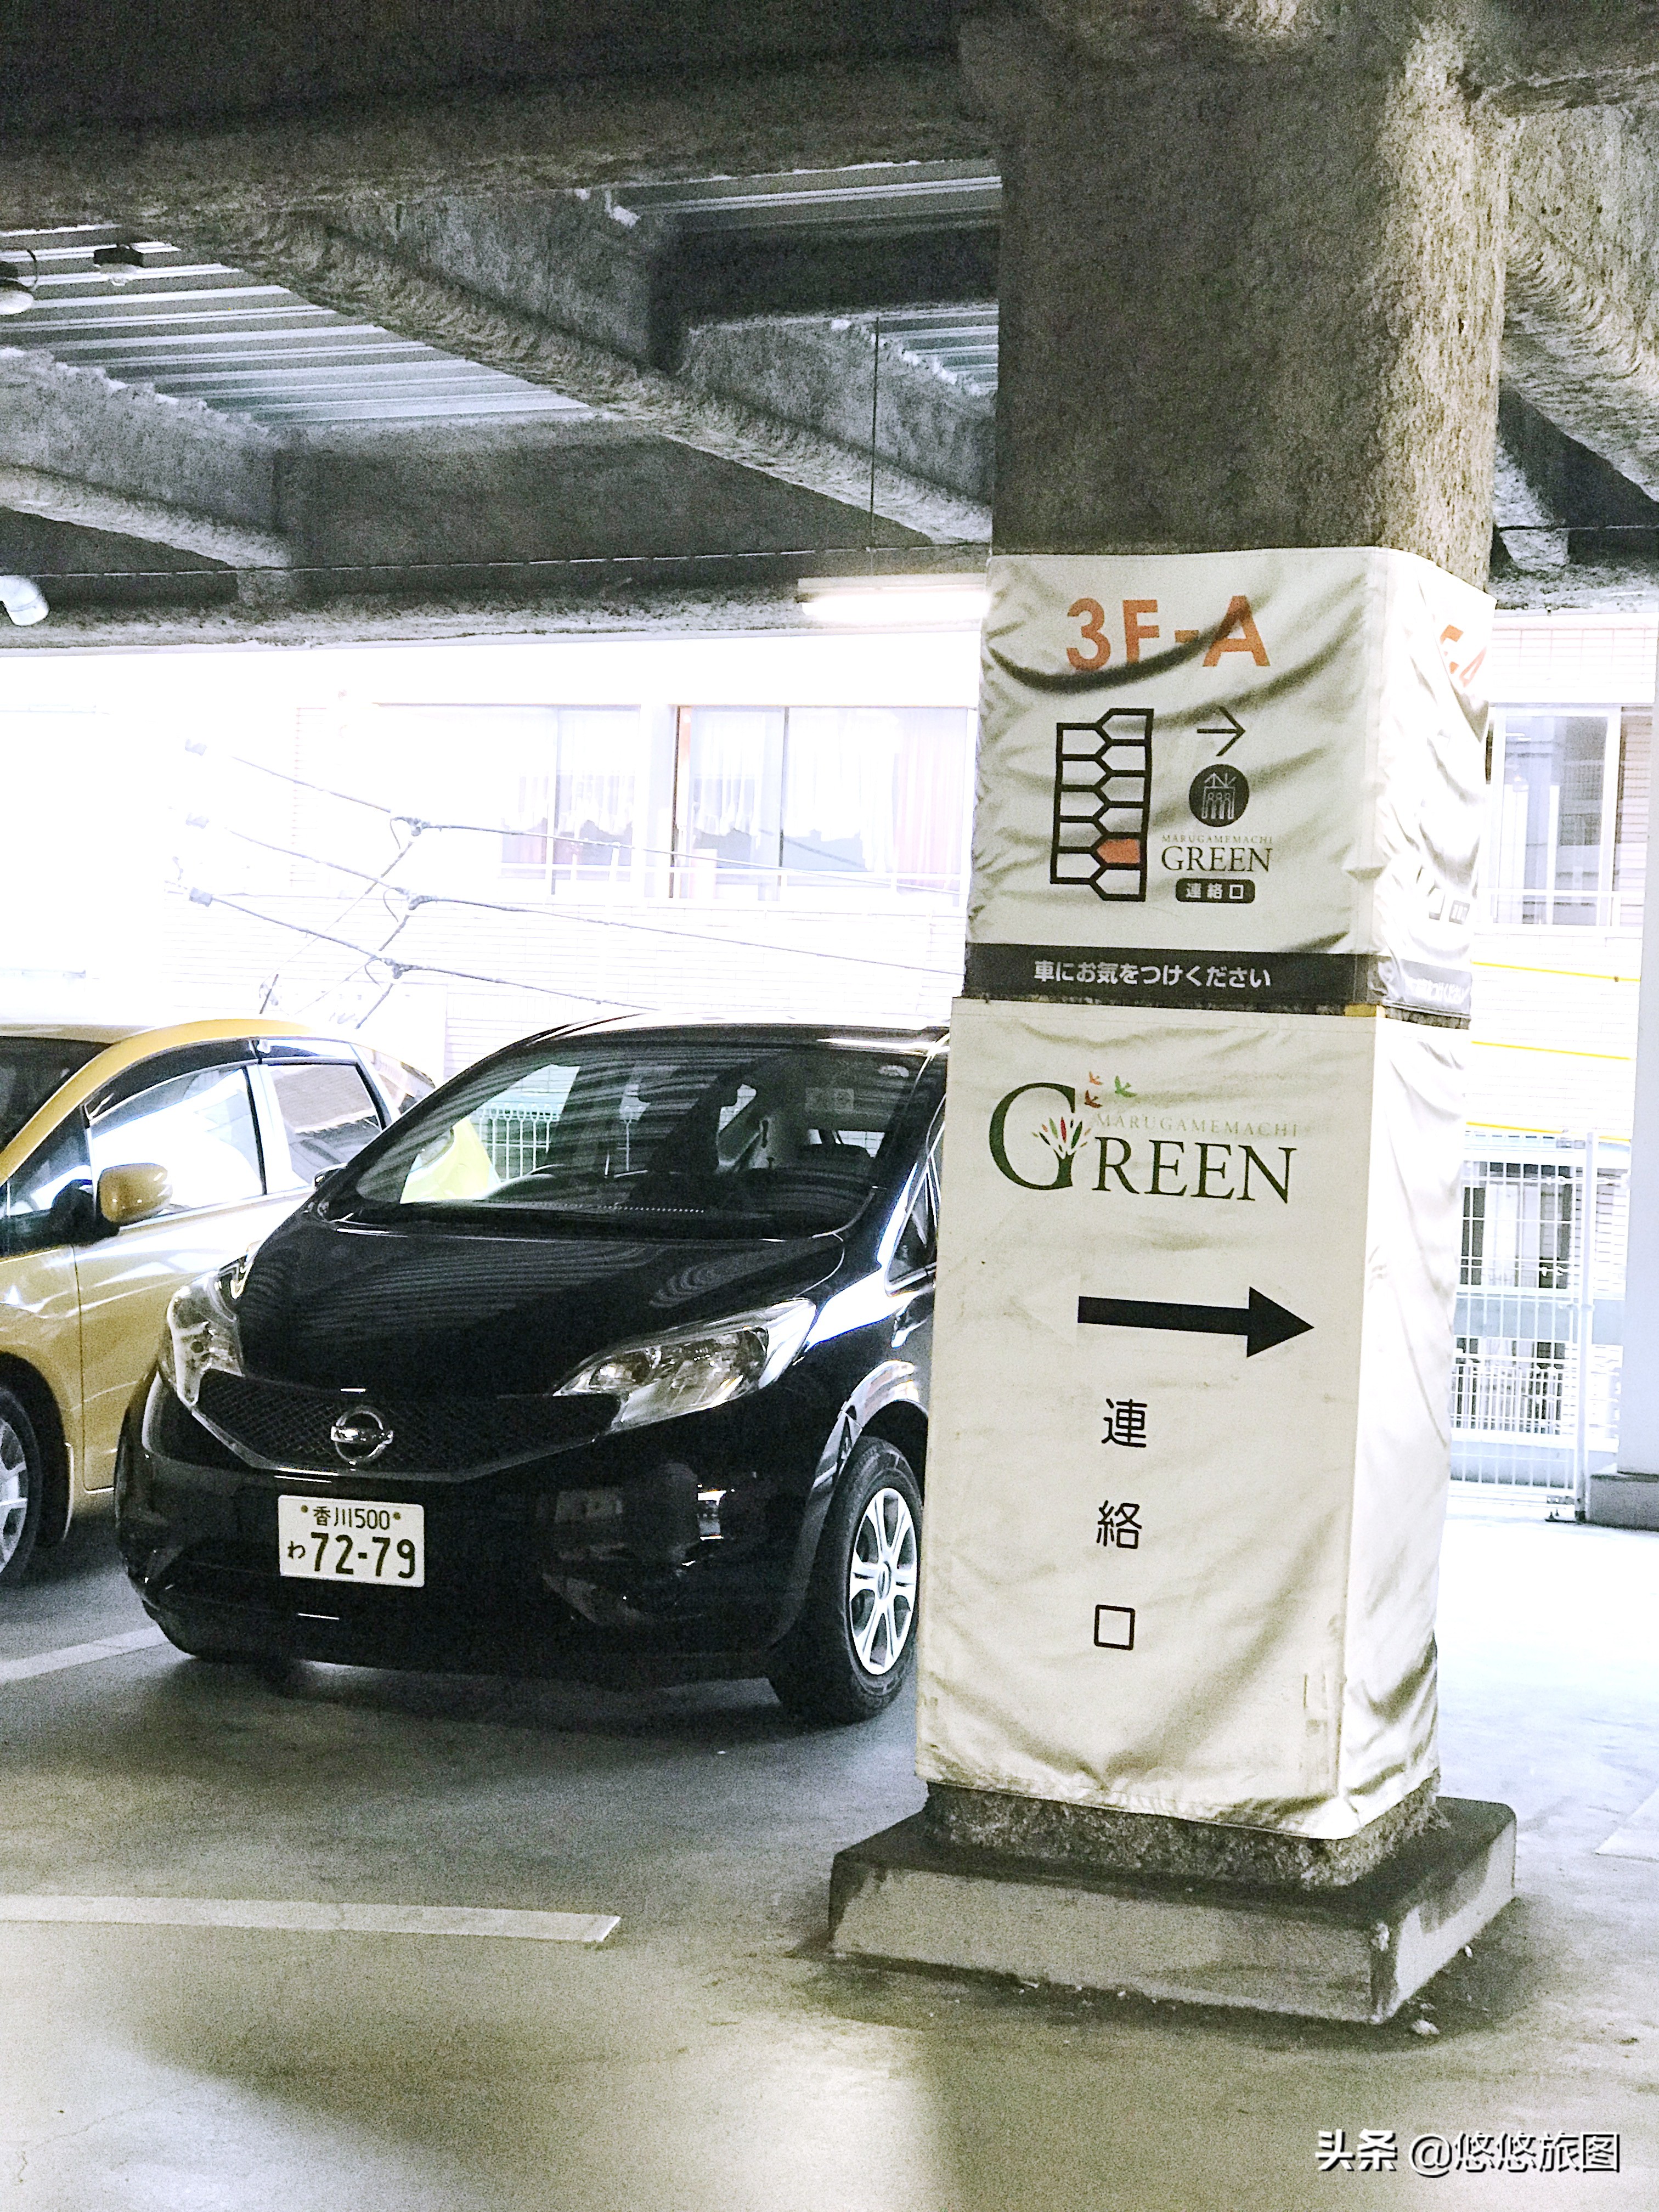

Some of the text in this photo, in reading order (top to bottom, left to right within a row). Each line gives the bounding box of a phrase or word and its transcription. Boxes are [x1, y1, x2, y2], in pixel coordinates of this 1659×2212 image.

[1066, 595, 1270, 671] 3F-A
[1161, 845, 1273, 872] GREEN
[1186, 882, 1244, 899] 連絡口
[1034, 960, 1271, 988] 車にお気をつけください
[1097, 1113, 1299, 1137] MARUGAMEMACHI
[989, 1082, 1297, 1204] GREEN
[287, 1532, 415, 1579] わ 72-79
